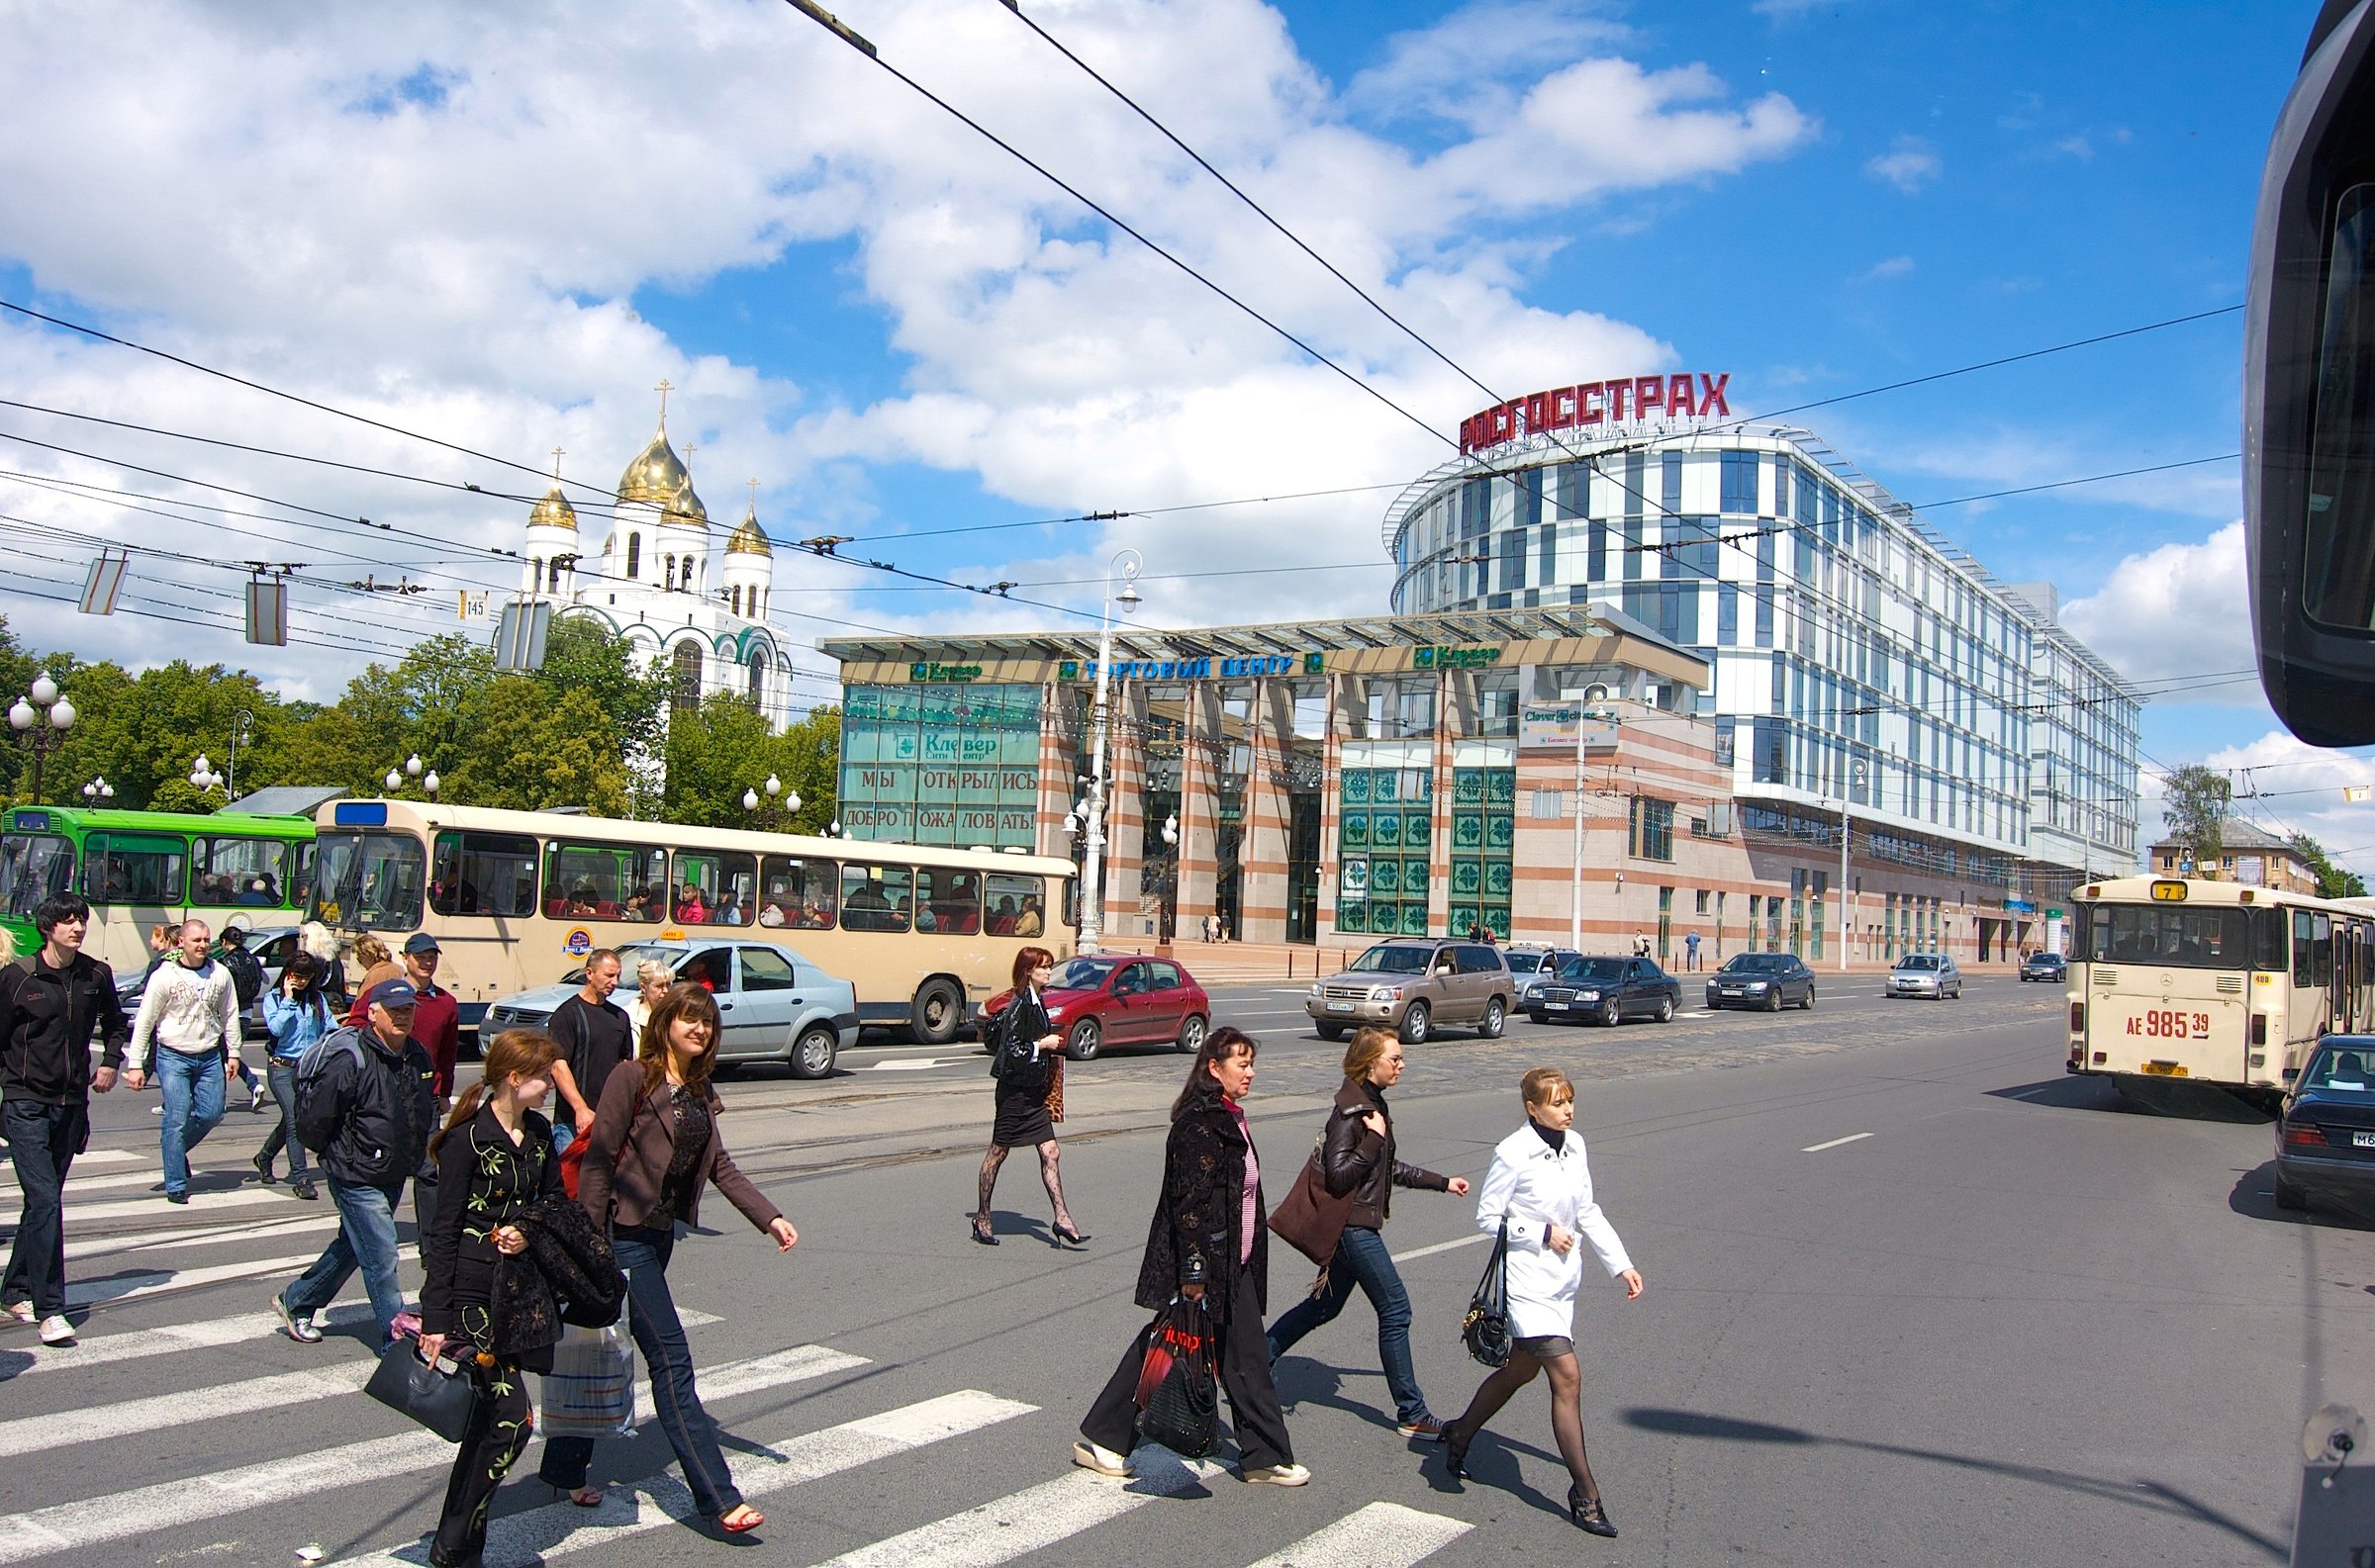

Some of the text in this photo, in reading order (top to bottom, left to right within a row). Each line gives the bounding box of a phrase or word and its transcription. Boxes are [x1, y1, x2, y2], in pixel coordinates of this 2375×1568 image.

[1460, 372, 1730, 456] РОСГОССТРАХ
[467, 600, 484, 615] 145
[1220, 655, 1293, 677] ЦЕНТР
[1525, 711, 1556, 721] Clover
[925, 735, 997, 755] Клевер
[925, 751, 949, 760] Сити
[862, 771, 1037, 790] МЫ ОТКРЫЛИСЬ
[844, 810, 1034, 830] ДОБРО ПОЖАЛОВАТЬ!
[2163, 887, 2171, 899] 7
[2146, 1010, 2187, 1038] 985
[2192, 1013, 2209, 1032] 39
